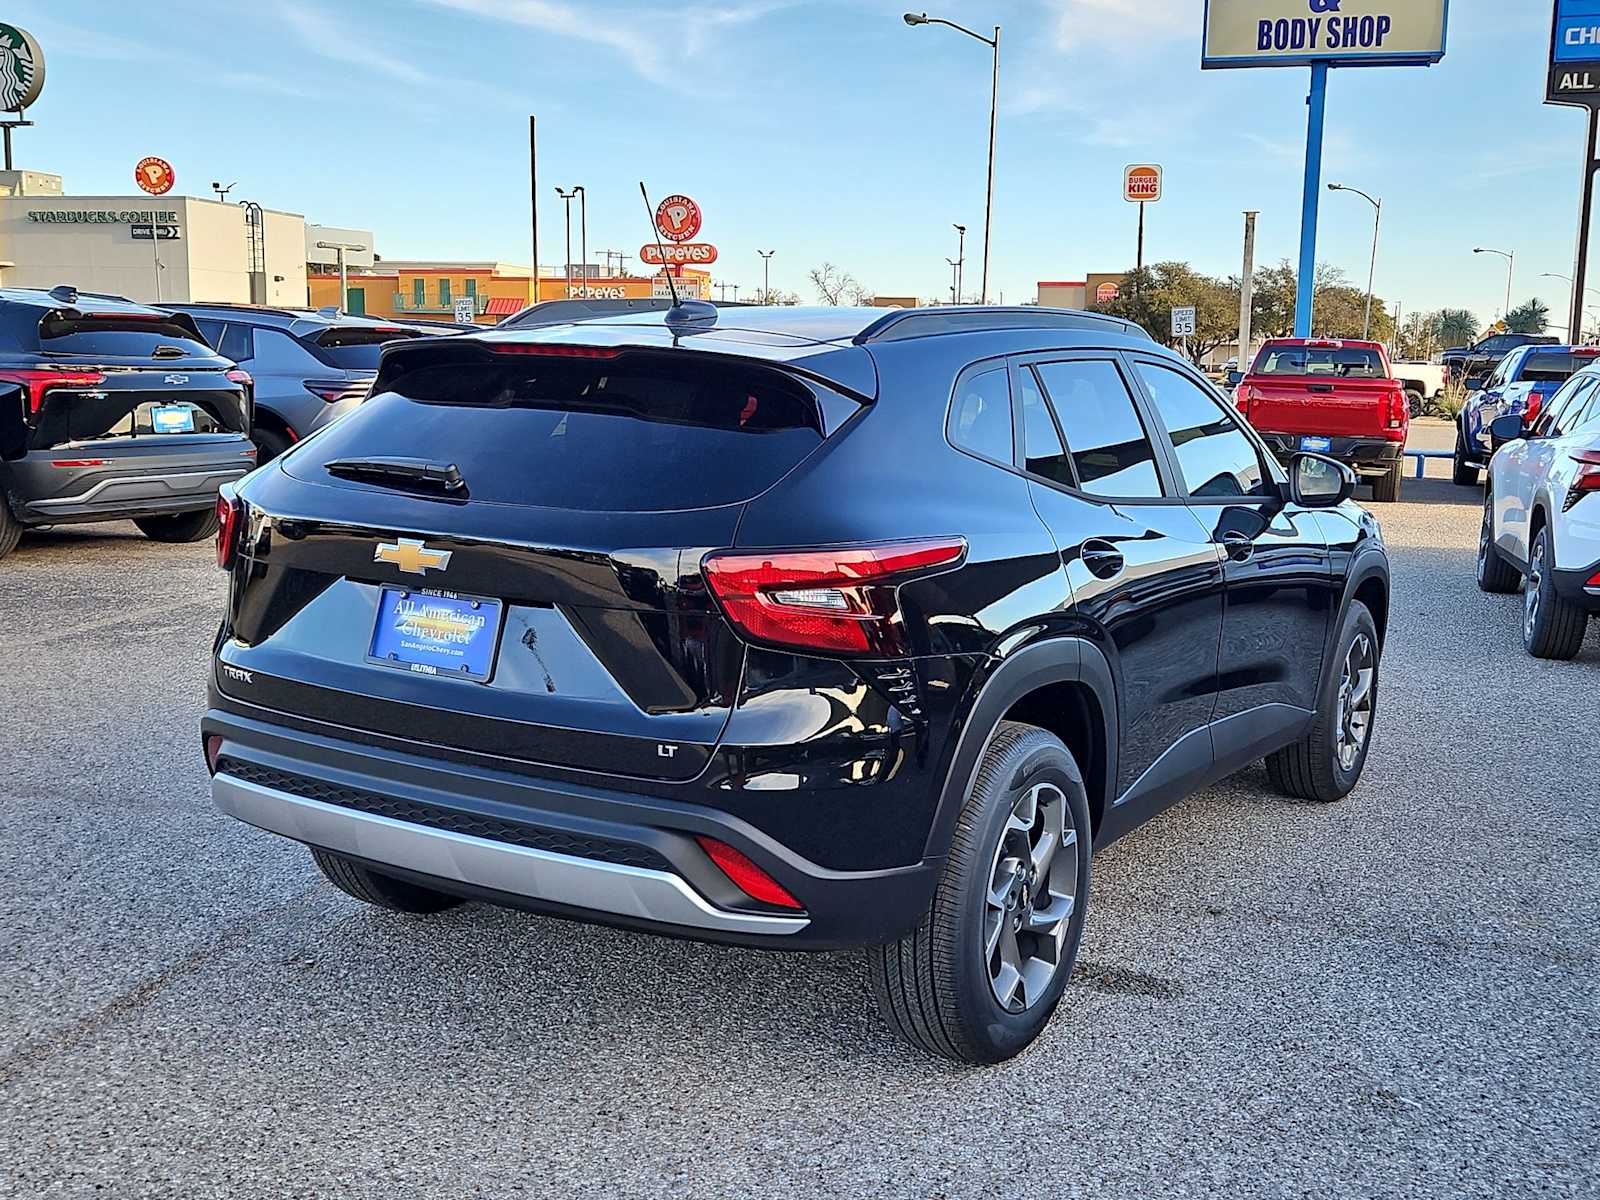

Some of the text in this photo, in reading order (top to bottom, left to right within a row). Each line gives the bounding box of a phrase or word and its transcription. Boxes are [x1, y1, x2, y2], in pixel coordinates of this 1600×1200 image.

[1257, 16, 1391, 50] BODY SHOP
[1565, 26, 1600, 45] CH
[1559, 72, 1595, 90] ALL
[143, 164, 163, 185] P
[1128, 184, 1157, 192] KING
[658, 196, 697, 215] LOUISIANA
[28, 211, 117, 223] STARBUCKS
[666, 205, 688, 230] P
[659, 224, 695, 241] KITCHEN
[458, 313, 472, 322] 35
[1175, 323, 1192, 333] 35
[421, 588, 442, 597] SINCE
[393, 600, 486, 627] All American
[402, 620, 471, 645] Chevrolet
[223, 665, 253, 684] TRAX
[657, 744, 678, 758] LT
